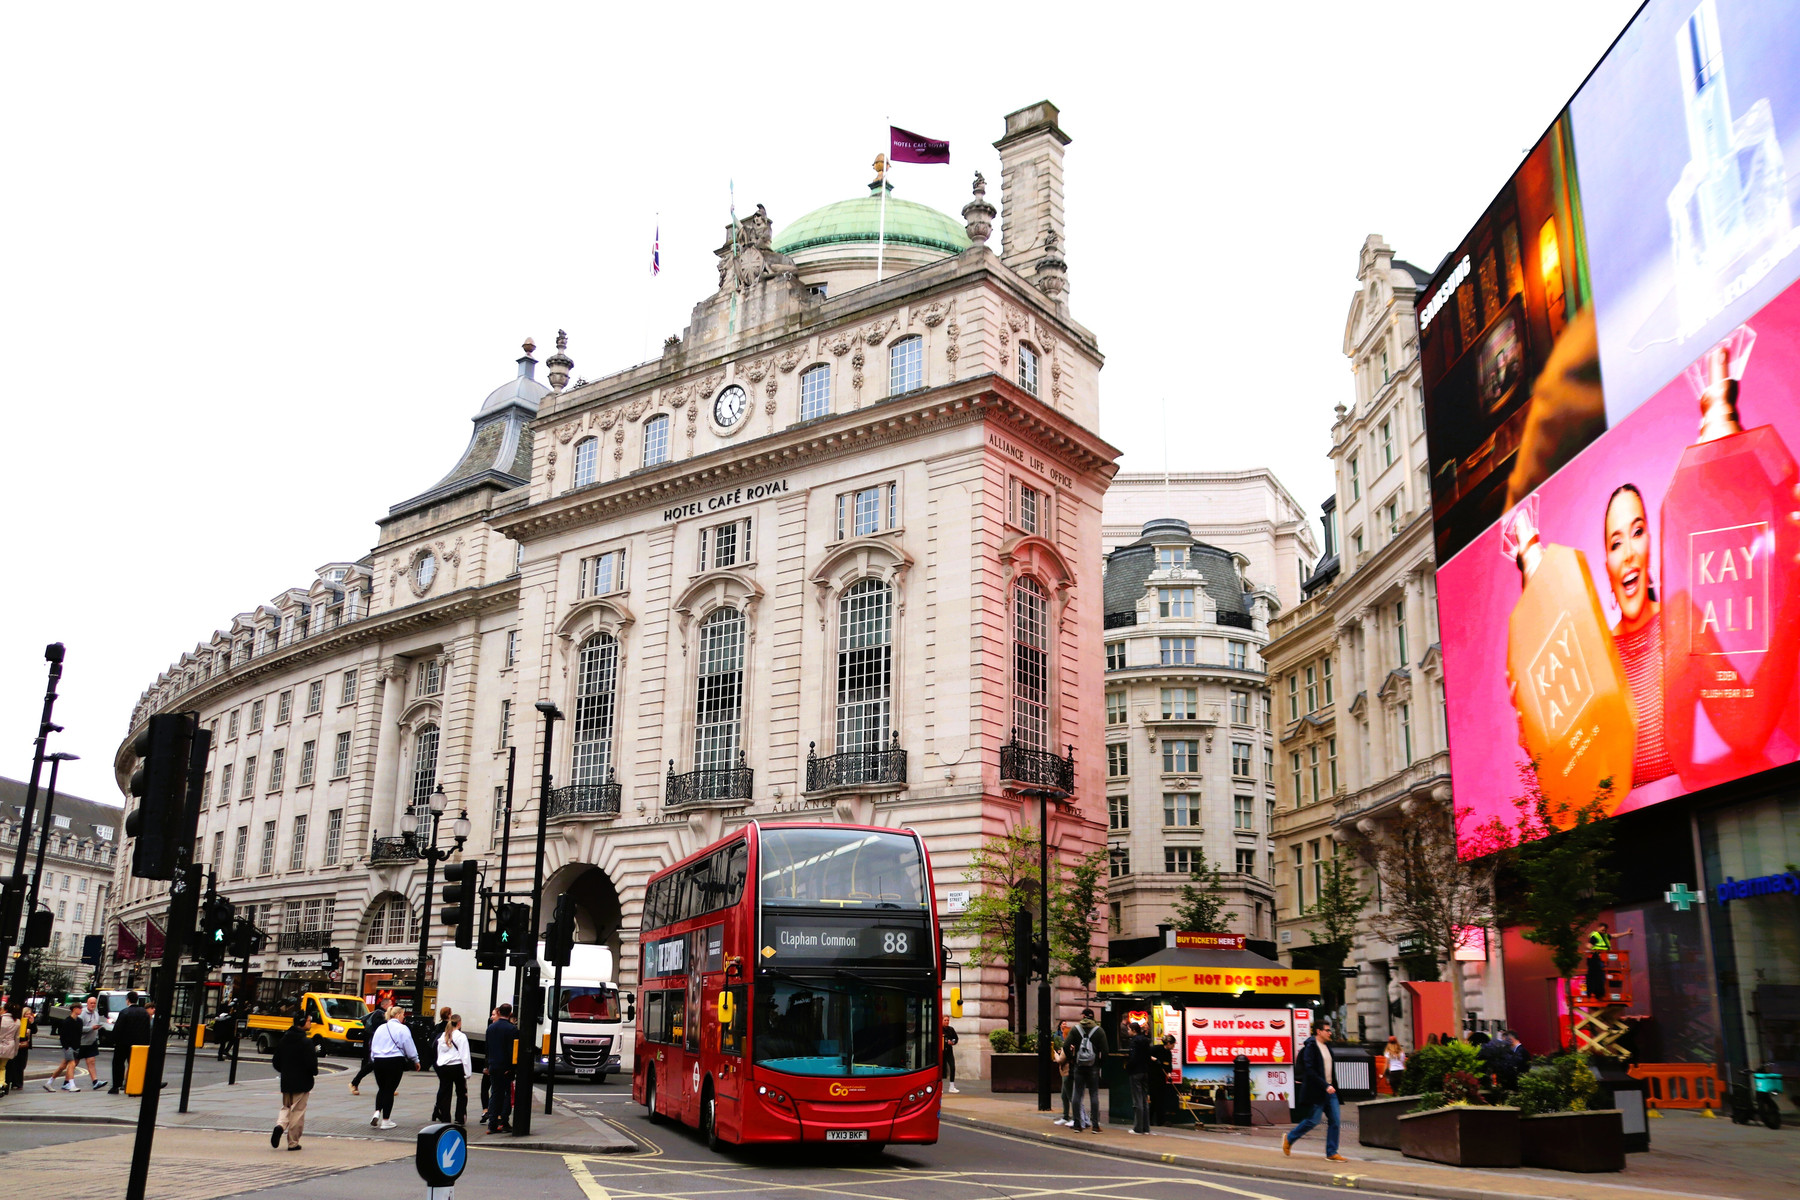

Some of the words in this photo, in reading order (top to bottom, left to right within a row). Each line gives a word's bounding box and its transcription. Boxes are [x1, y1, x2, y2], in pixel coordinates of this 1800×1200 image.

[893, 140, 911, 148] HOTEL
[1420, 254, 1471, 331] SAMSUNG
[989, 433, 1024, 462] ALLIANCE
[1030, 456, 1045, 473] LIFE
[1050, 468, 1073, 489] OFFICE
[663, 502, 703, 521] HOTEL
[708, 488, 741, 510] CAFÉ
[746, 479, 789, 500] ROYAL
[1698, 546, 1760, 585] KAY
[1699, 596, 1754, 634] ALI
[1536, 628, 1571, 696] KAY
[1550, 667, 1581, 728] ALI
[646, 812, 691, 825] COUNTY
[720, 807, 746, 818] FIRE
[772, 799, 836, 814] ALLIANCE
[870, 792, 901, 804] LIFE
[780, 930, 818, 949] Clapham
[821, 932, 856, 947] Common
[883, 932, 908, 954] 88
[1176, 935, 1190, 944] BUY
[1191, 936, 1218, 945] TICKETS
[1218, 937, 1236, 946] HERE
[372, 956, 392, 966] Fanatics
[1100, 974, 1115, 985] HOT
[1117, 973, 1133, 984] DOG
[1135, 972, 1157, 984] SPOT
[1194, 974, 1222, 985] HOT
[1225, 974, 1252, 986] DOG
[1255, 975, 1289, 987] SPOT
[1213, 1020, 1235, 1030] HOT
[1237, 1020, 1265, 1030] DOGS
[1211, 1047, 1229, 1056] ICE
[1231, 1047, 1268, 1057] CREAM
[1267, 1071, 1279, 1079] BIG
[829, 1082, 849, 1097] Go
[830, 1131, 848, 1139] YX13
[849, 1131, 864, 1139] BKF
